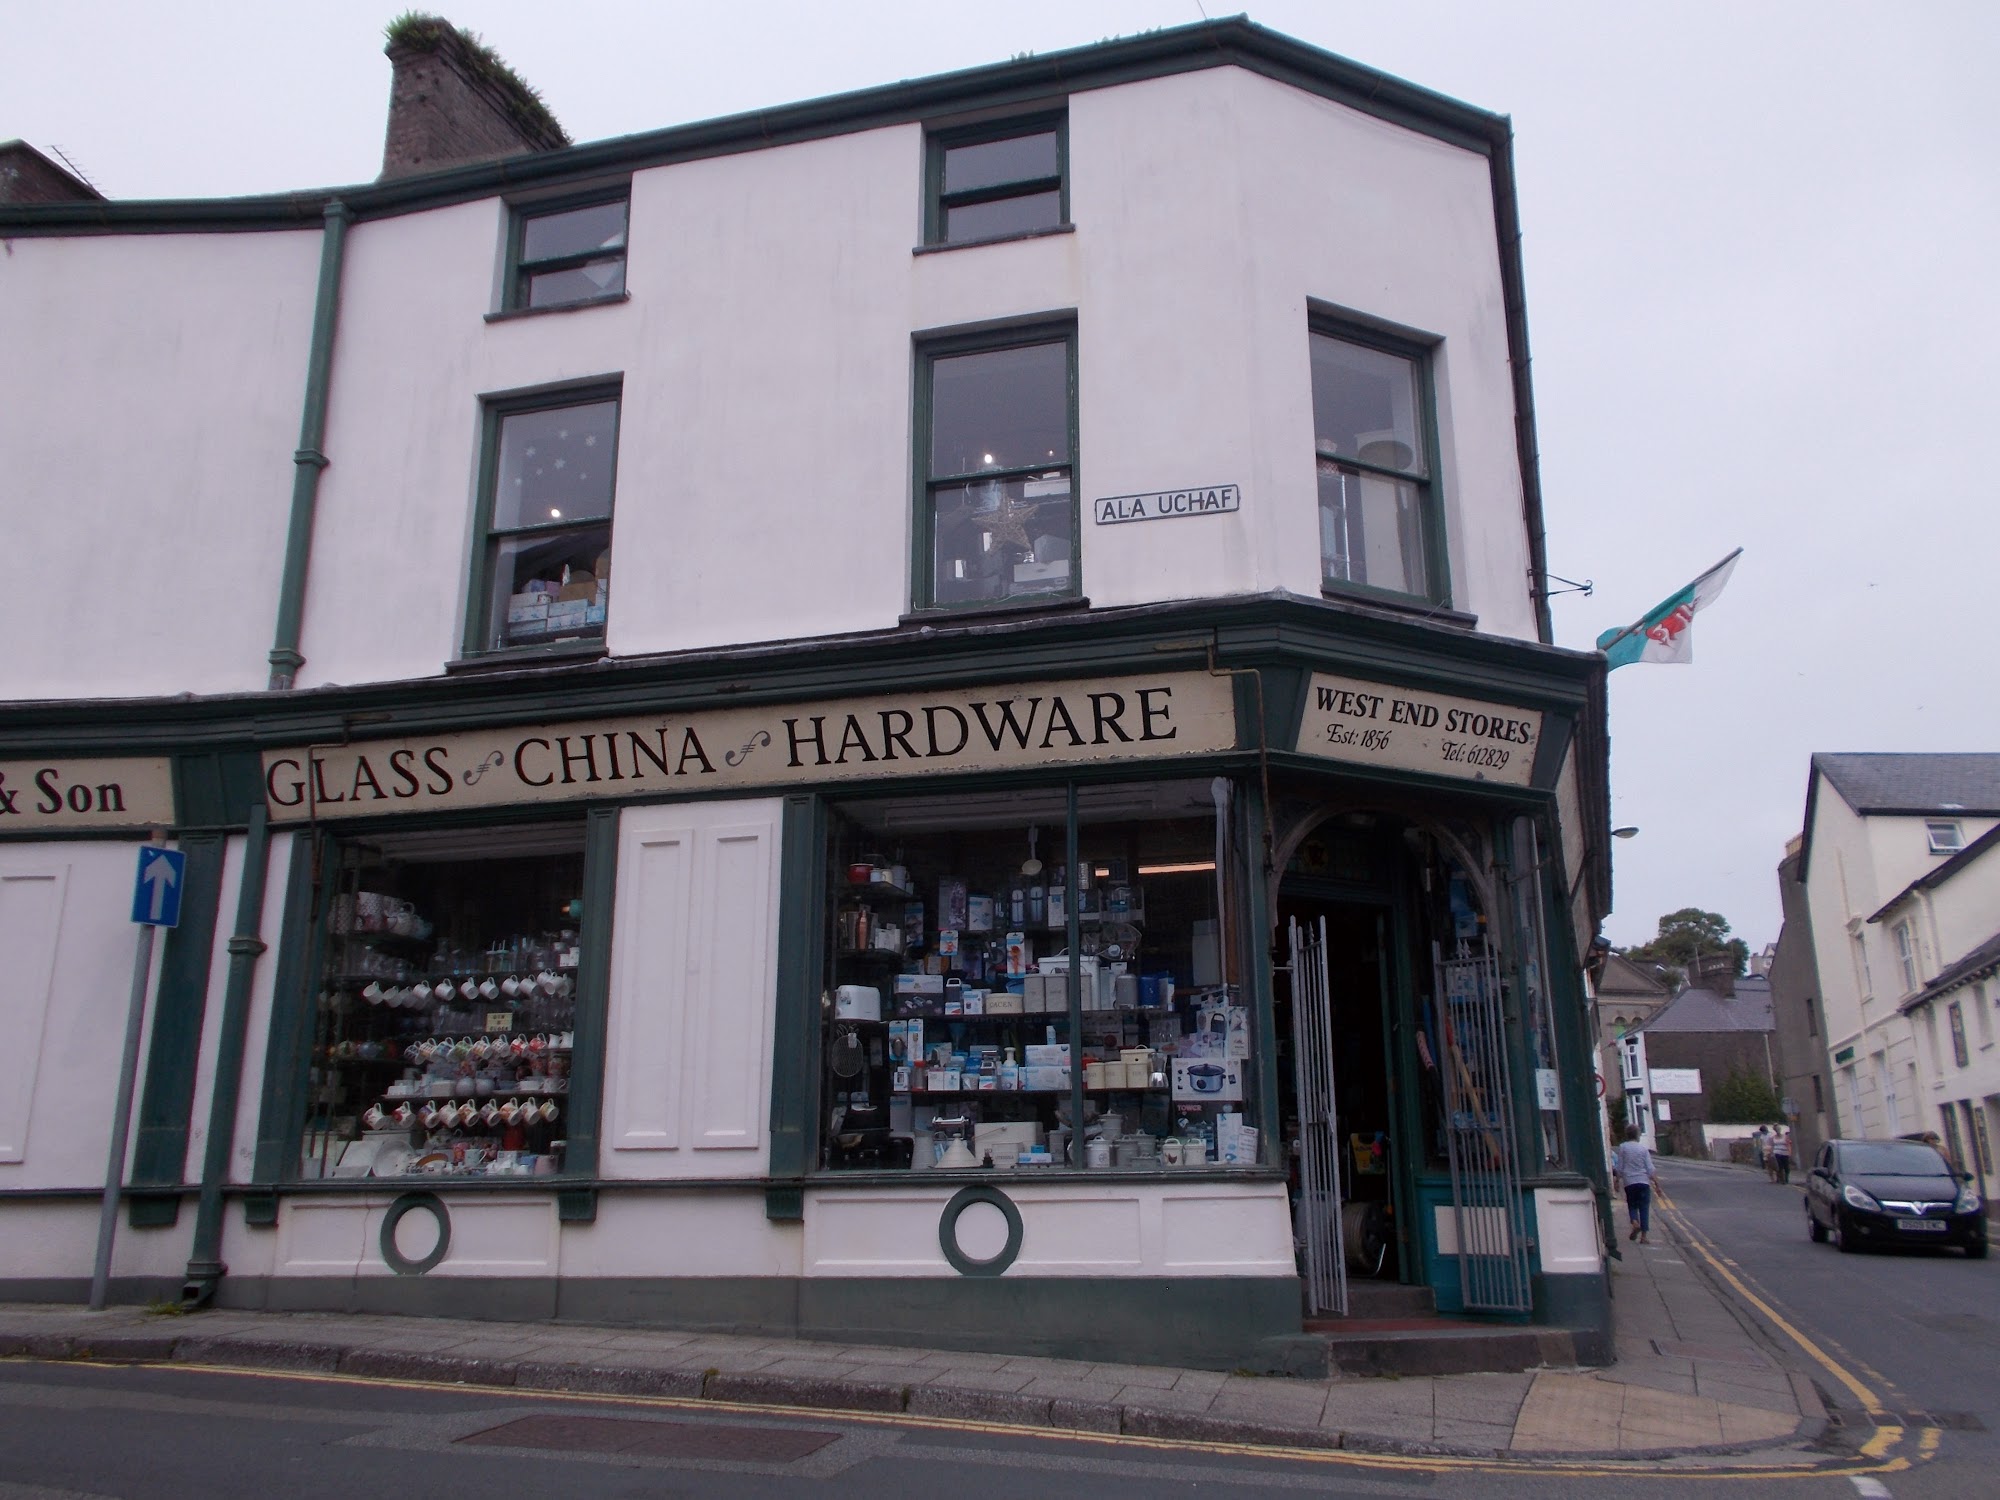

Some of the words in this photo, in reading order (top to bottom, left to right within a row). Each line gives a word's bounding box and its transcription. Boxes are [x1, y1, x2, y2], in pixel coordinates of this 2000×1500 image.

[1101, 498, 1146, 520] ALA
[1158, 488, 1232, 514] UCHAF
[1316, 686, 1384, 719] WEST
[1389, 700, 1439, 728] END
[1445, 708, 1531, 744] STORES
[266, 745, 454, 807] GLASS
[513, 726, 716, 788] CHINA
[783, 687, 1178, 767] HARDWARE
[1326, 723, 1359, 746] Est:
[1360, 728, 1393, 752] 1856
[1441, 742, 1466, 763] Tel:
[1467, 745, 1511, 770] 612829
[35, 768, 127, 814] Son
